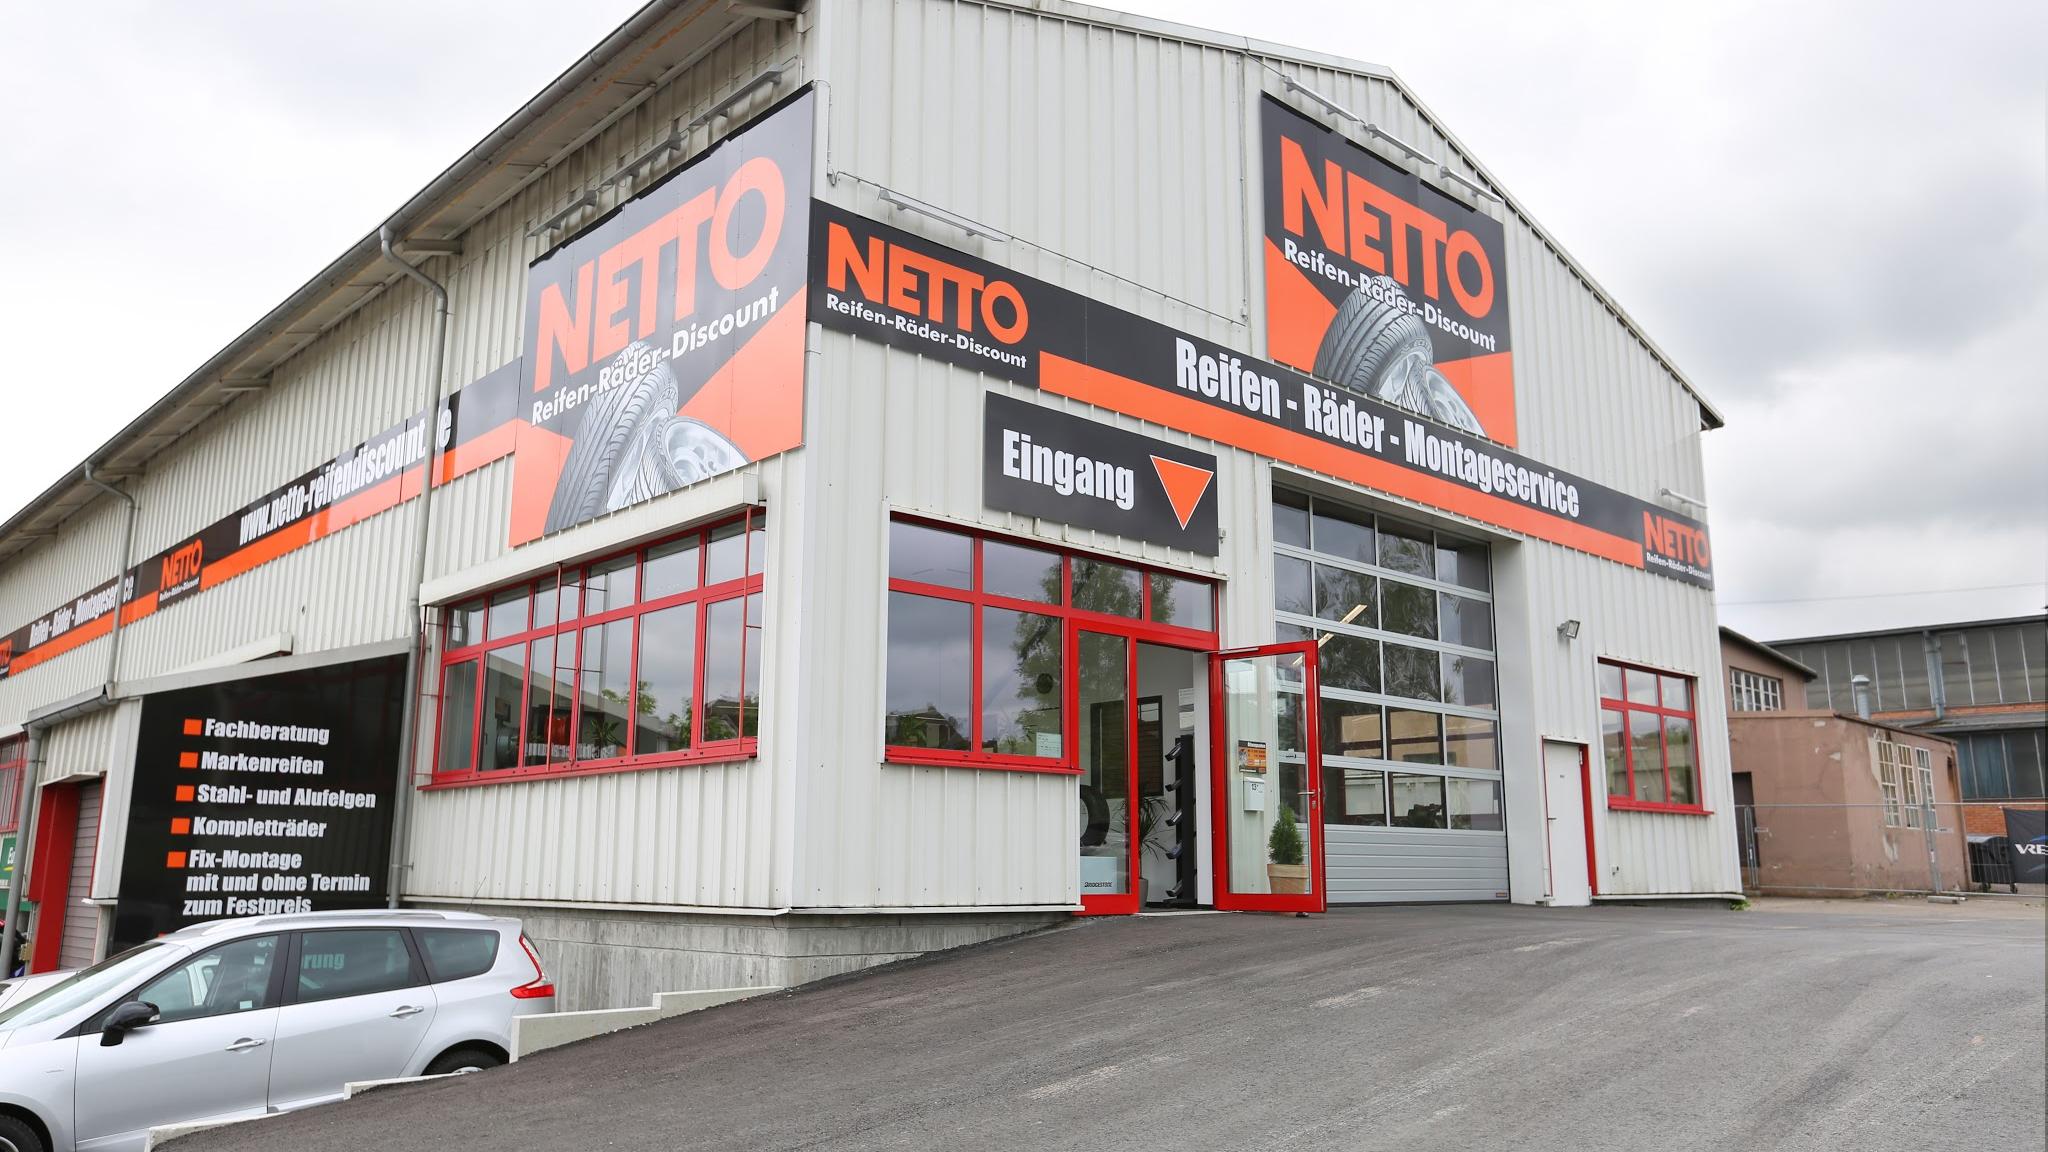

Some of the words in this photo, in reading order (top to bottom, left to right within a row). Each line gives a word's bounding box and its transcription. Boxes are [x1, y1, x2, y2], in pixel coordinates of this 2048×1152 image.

[1281, 135, 1494, 319] NETTO
[534, 157, 785, 393] NETTO
[827, 222, 1029, 345] NETTO
[1284, 238, 1495, 351] Reifen-Räder-Discount
[531, 286, 778, 426] Reifen-Räder-Discount
[827, 293, 1027, 369] Reifen-Räder-Discount
[1176, 337, 1280, 419] Reifen
[1304, 383, 1385, 453] Räder
[1404, 419, 1580, 517] Montageservice
[1003, 428, 1134, 511] Eingang
[160, 539, 203, 592] NETTO
[1643, 511, 1710, 569] NETTO
[205, 718, 330, 745] Fachberatung
[201, 752, 324, 775] Markenreifen
[197, 784, 253, 804] Stahl-
[256, 787, 293, 806] und
[294, 788, 376, 809] Alufelgen
[193, 816, 327, 837] Kompletträder
[186, 874, 218, 892] mit
[222, 874, 258, 892] und
[262, 874, 307, 891] ohne
[311, 873, 370, 891] Termin
[189, 850, 302, 870] Fix-Montage
[183, 899, 222, 916] zum
[226, 896, 312, 916] Festpreis
